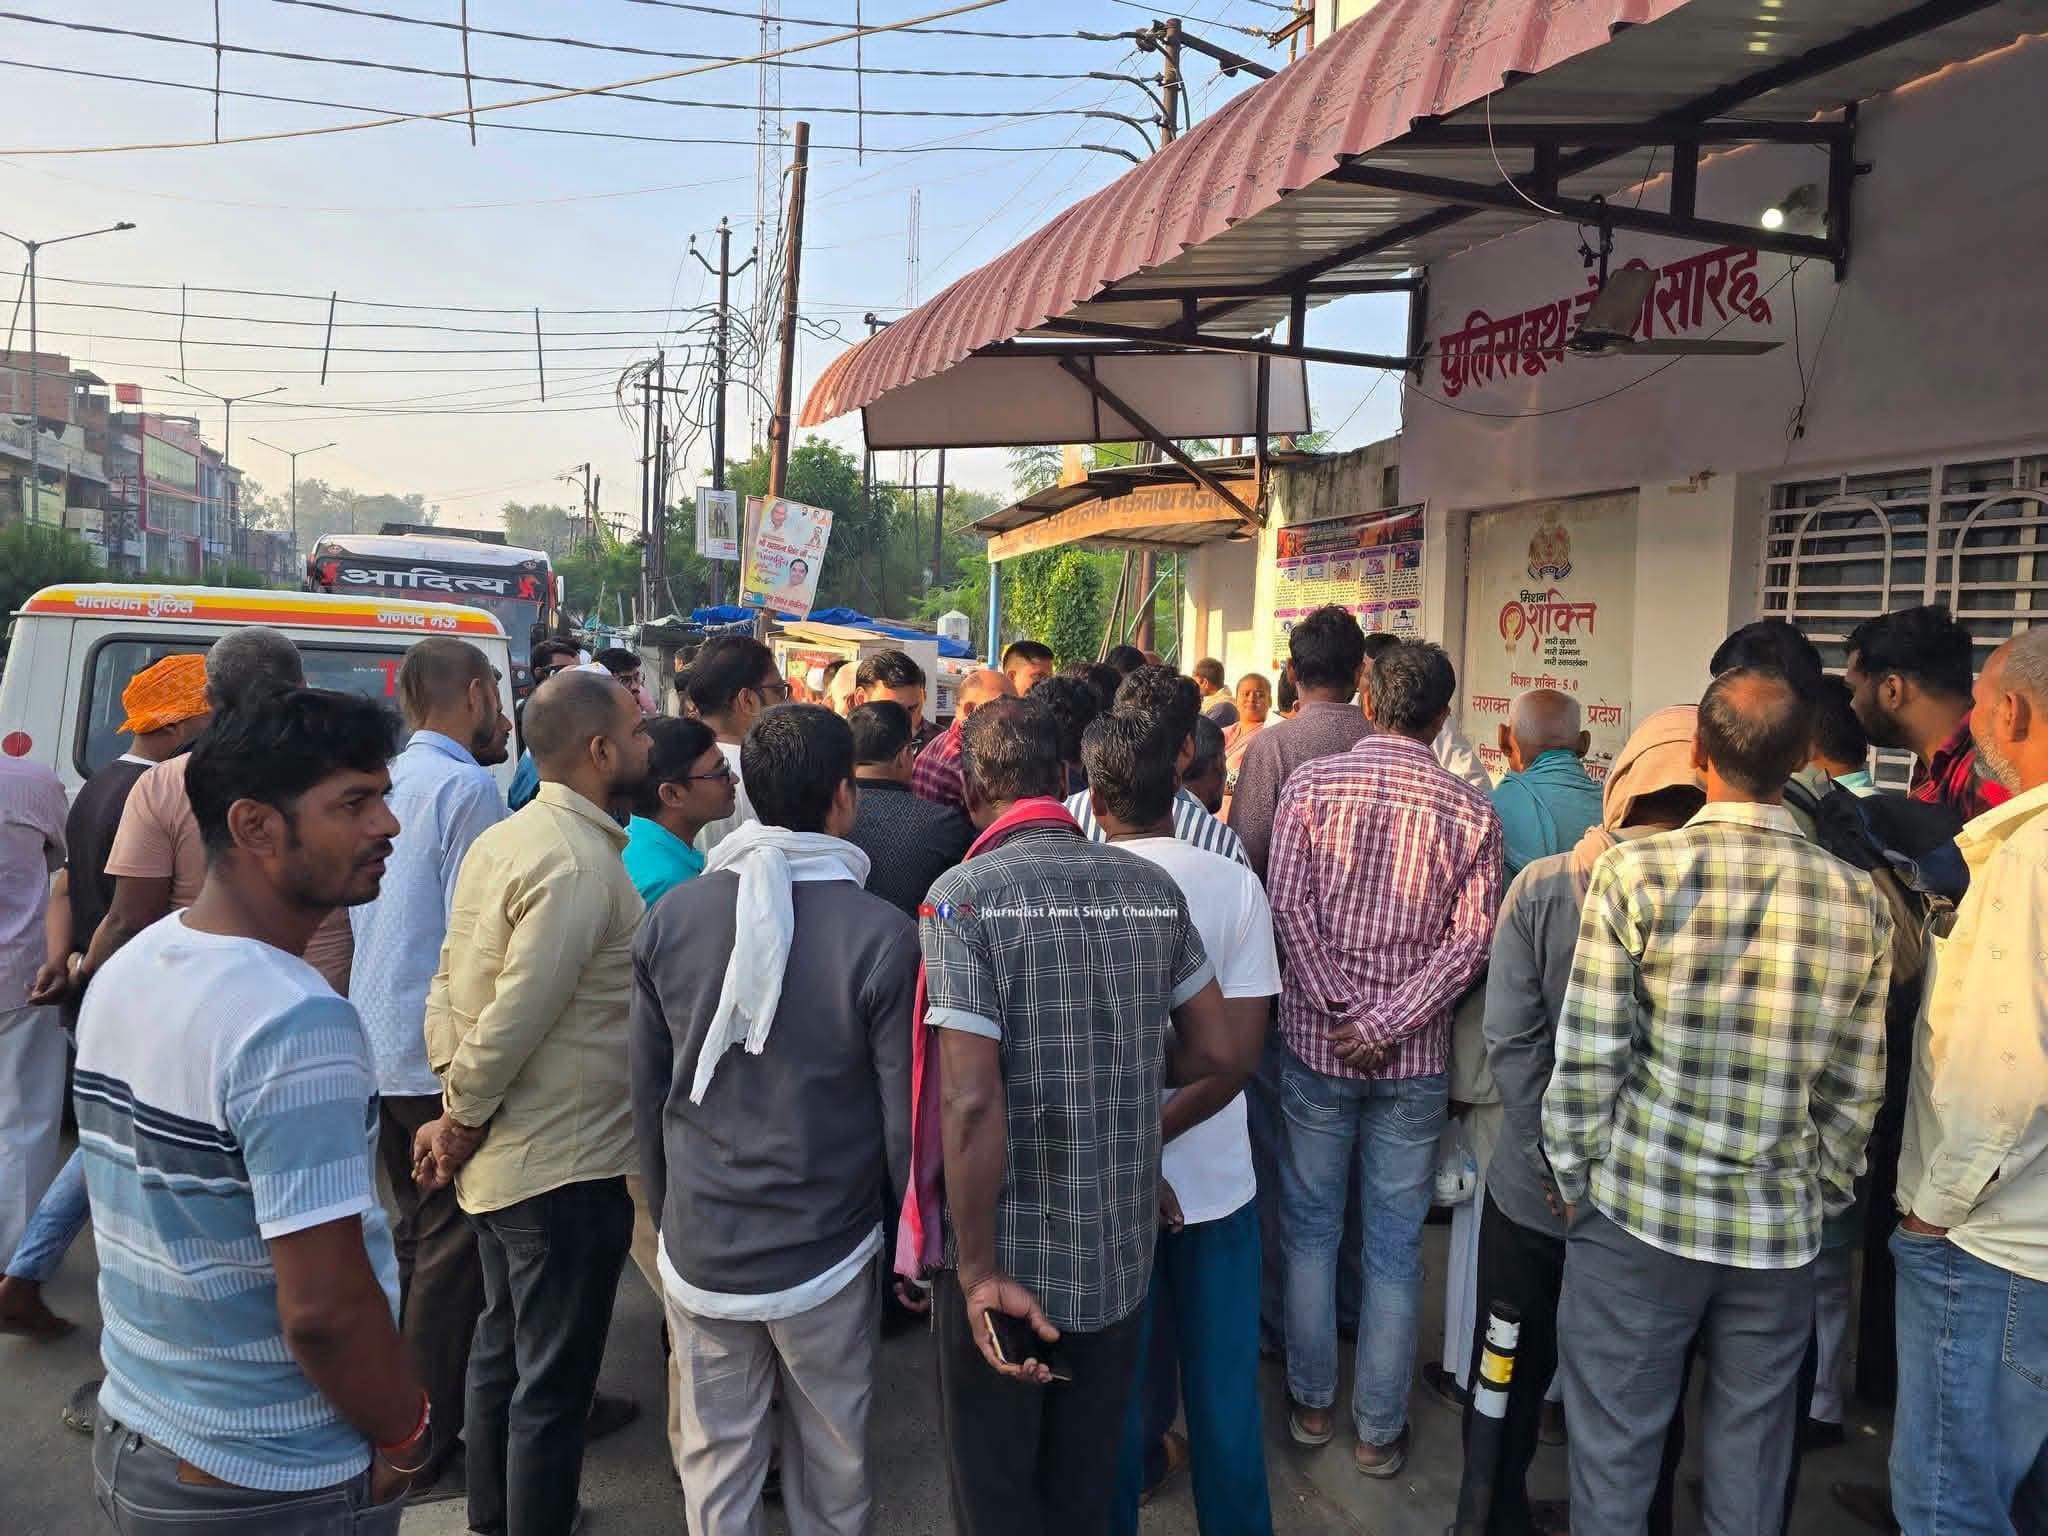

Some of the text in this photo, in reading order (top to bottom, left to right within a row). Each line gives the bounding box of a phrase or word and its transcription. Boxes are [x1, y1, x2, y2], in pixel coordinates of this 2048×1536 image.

[341, 568, 511, 594] आदित्य
[75, 593, 192, 617] यातायात पुलिस
[1520, 590, 1547, 603] मिशन
[377, 610, 456, 629] जनपद मऊ
[1526, 588, 1597, 655] शक्ति
[1544, 636, 1557, 645] नारी
[1544, 647, 1580, 656] नारी सम्मान
[1511, 672, 1531, 687] मिशन
[1473, 695, 1622, 727] सशक्त प्रदेश
[1480, 744, 1502, 761] मिशन
